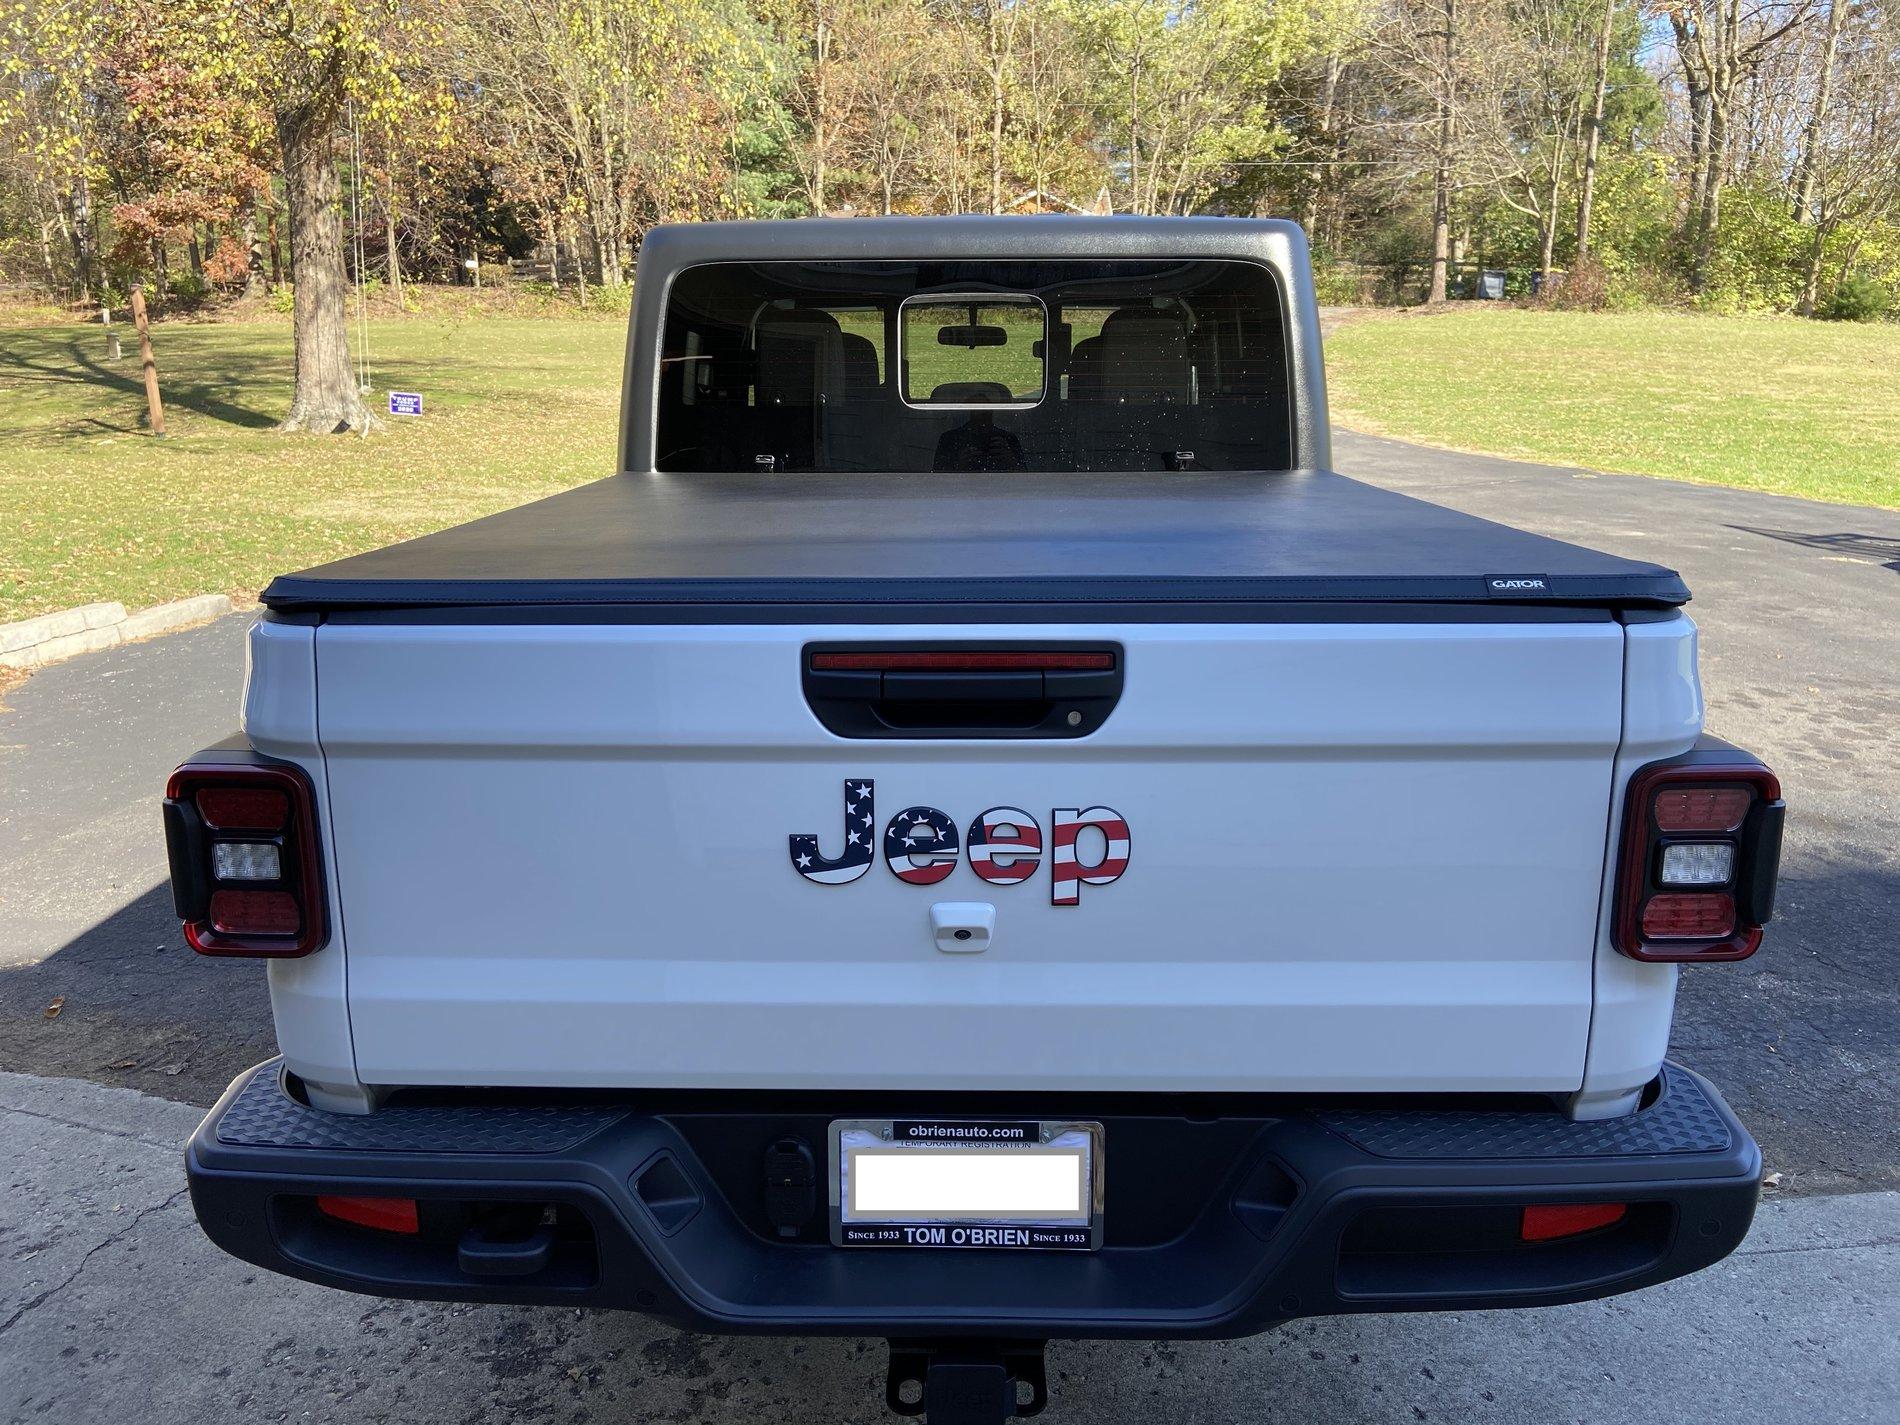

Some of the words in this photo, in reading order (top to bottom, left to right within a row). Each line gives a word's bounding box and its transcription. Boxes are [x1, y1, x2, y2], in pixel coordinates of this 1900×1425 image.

[1492, 580, 1545, 588] GATOR
[789, 778, 1132, 906] Jeep
[909, 1125, 1024, 1138] obrienauto.com
[878, 1231, 900, 1239] 1933
[904, 1228, 945, 1243] TOM
[951, 1229, 1029, 1245] O'BRIEN
[1064, 1234, 1086, 1243] 1933
